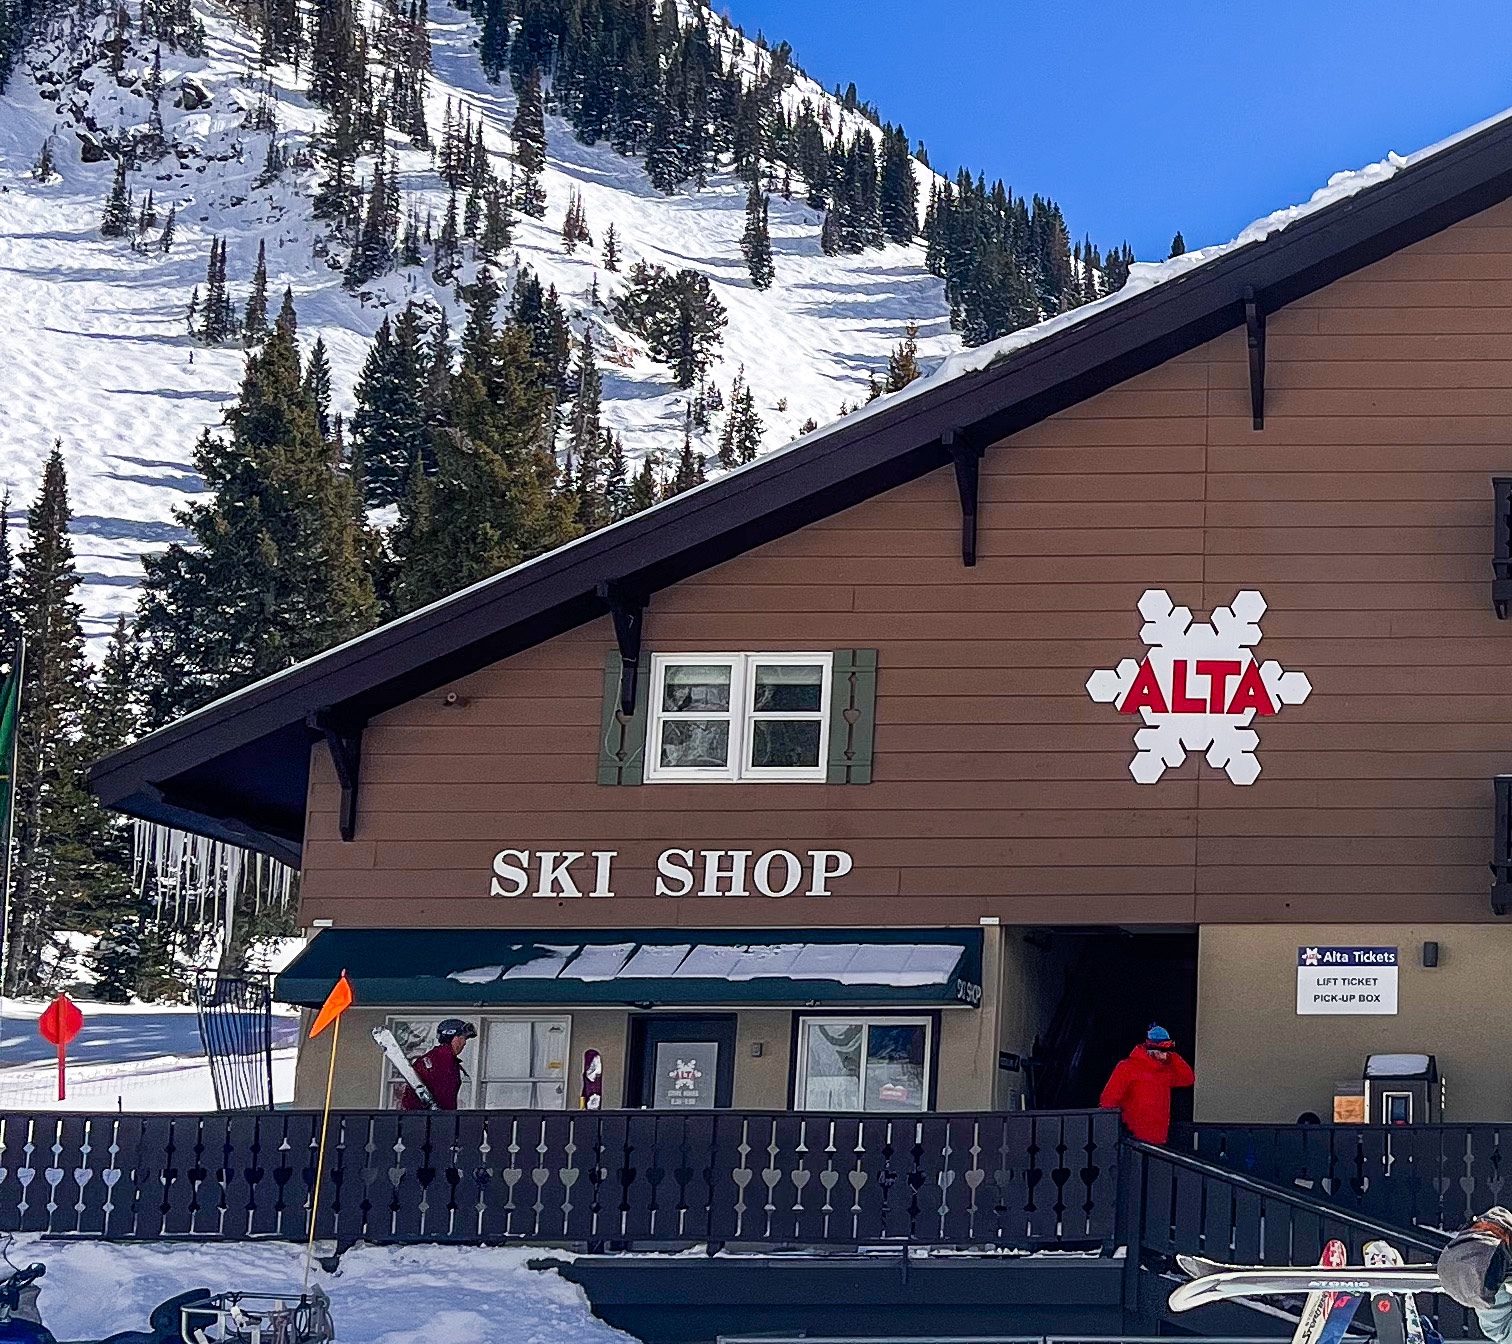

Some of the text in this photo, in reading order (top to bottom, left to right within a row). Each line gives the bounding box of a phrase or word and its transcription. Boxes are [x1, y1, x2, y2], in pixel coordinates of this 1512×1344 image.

[1120, 656, 1276, 716] ALTA
[490, 849, 853, 898] SKI SHOP
[1323, 951, 1349, 962] Alta
[1353, 951, 1395, 962] Tickets
[1316, 977, 1379, 986] LIFT TICKET
[1313, 994, 1381, 1003] PICK-UP BOX
